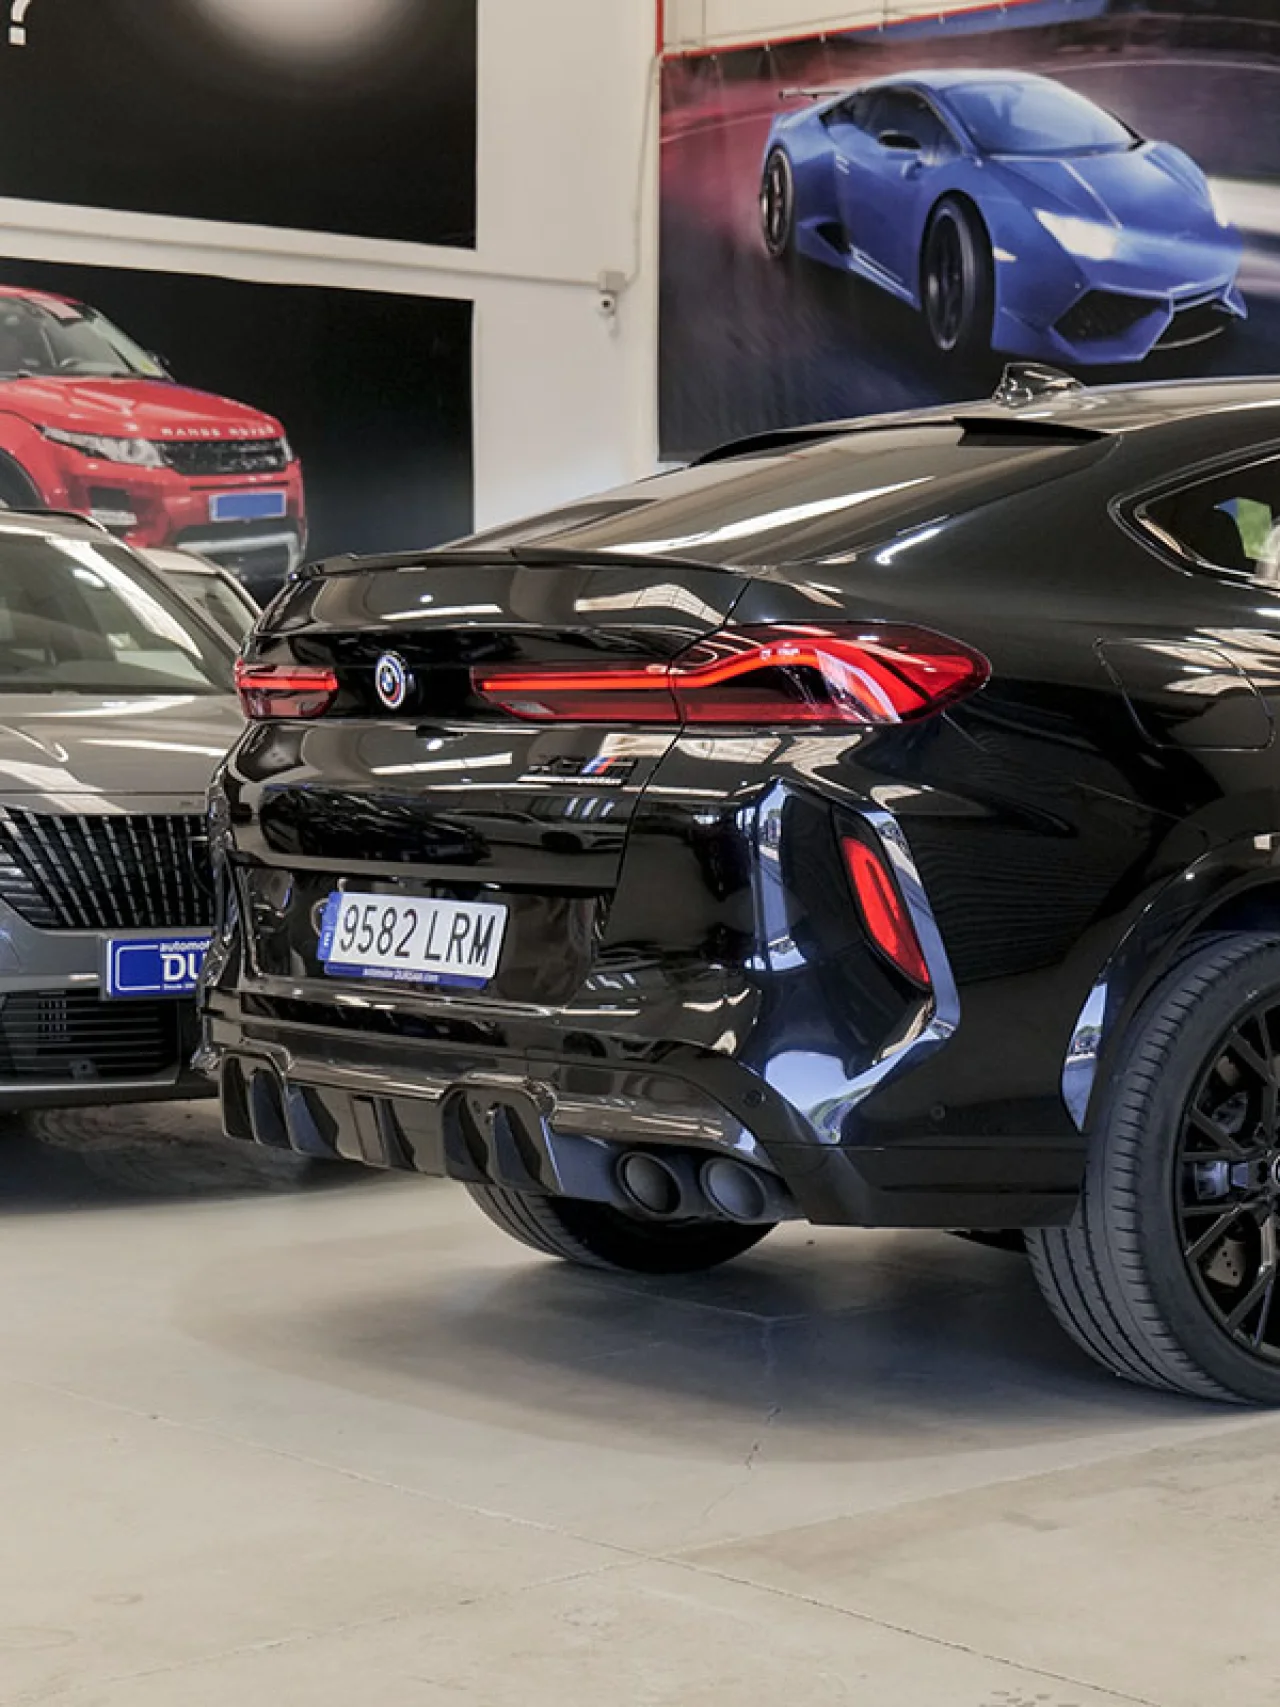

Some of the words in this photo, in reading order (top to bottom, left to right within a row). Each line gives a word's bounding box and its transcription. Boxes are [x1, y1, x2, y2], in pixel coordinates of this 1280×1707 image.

[340, 904, 418, 959] 9582
[424, 910, 496, 966] LRM
[160, 953, 207, 982] DU
